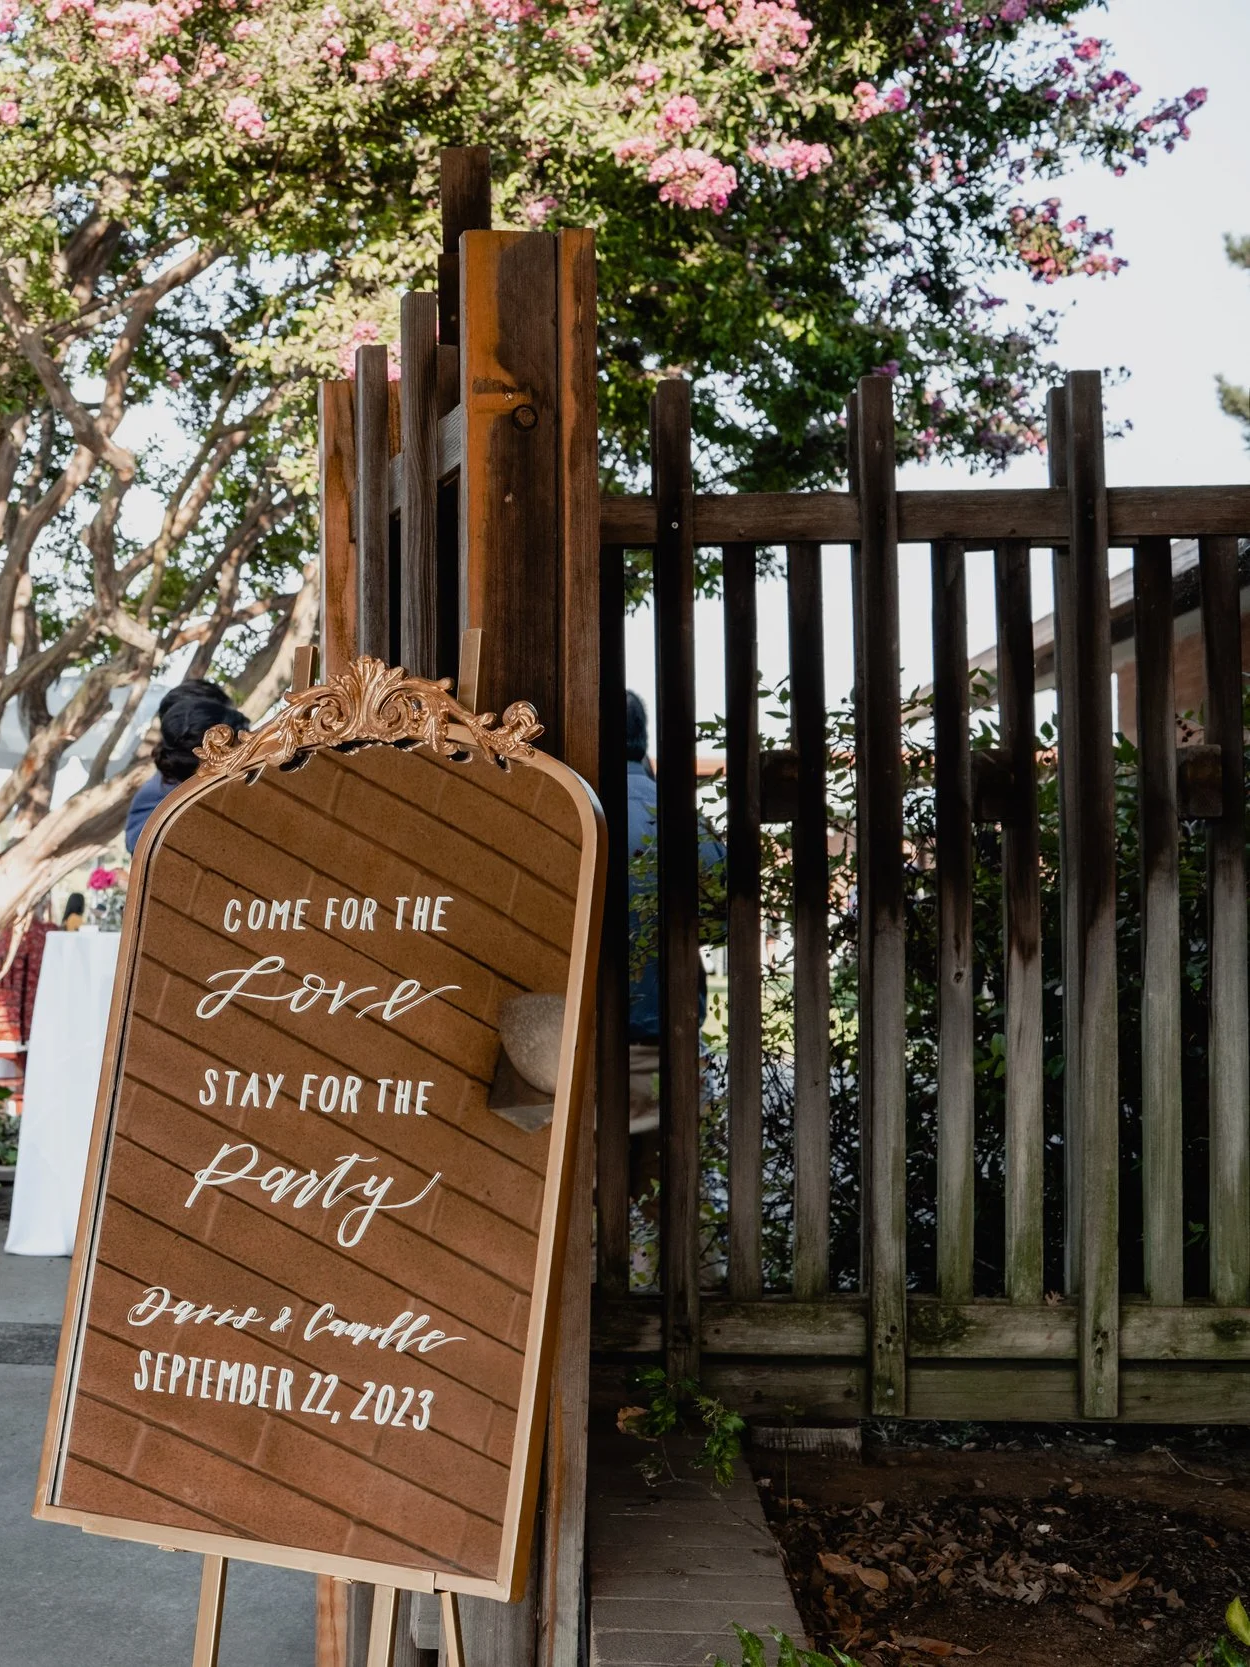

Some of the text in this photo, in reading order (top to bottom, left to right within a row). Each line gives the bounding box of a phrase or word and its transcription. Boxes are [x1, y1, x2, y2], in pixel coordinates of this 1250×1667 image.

[223, 896, 454, 933] COME FOR THE
[195, 955, 462, 1021] Love
[199, 1068, 435, 1116] STAY FOR THE
[269, 1306, 293, 1333] &
[303, 1302, 467, 1353] Camille
[134, 1349, 435, 1431] SEPTEMBER 22, 2023
